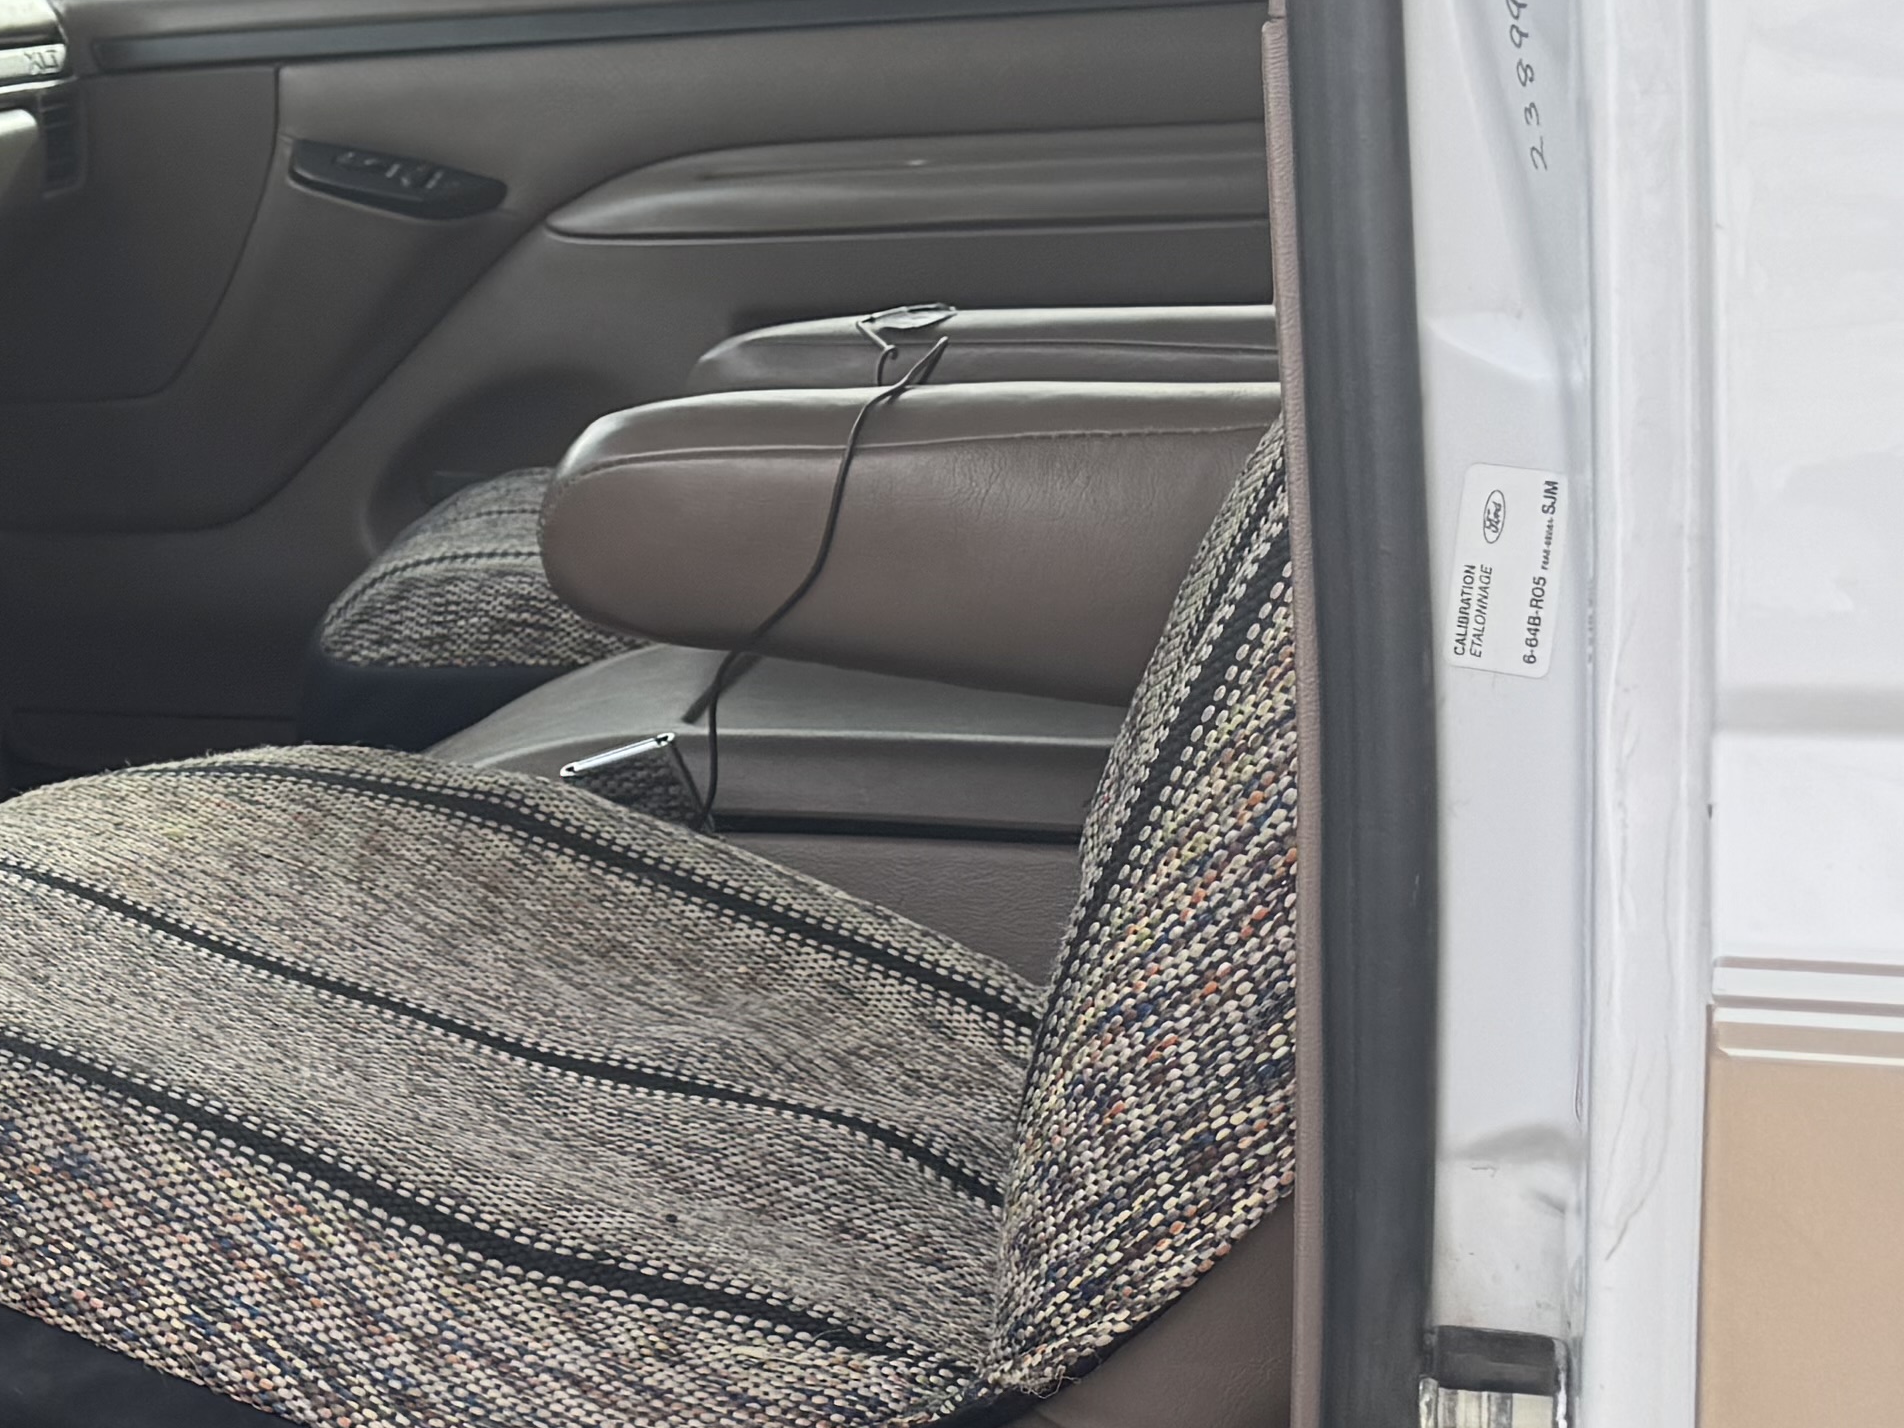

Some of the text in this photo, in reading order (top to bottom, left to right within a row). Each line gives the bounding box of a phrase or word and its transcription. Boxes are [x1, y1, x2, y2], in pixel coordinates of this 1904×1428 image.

[23, 48, 60, 73] XLT
[1541, 480, 1559, 516] SJM
[1453, 564, 1476, 656] CALIBRATION
[1469, 564, 1493, 658] ETALONNAGE
